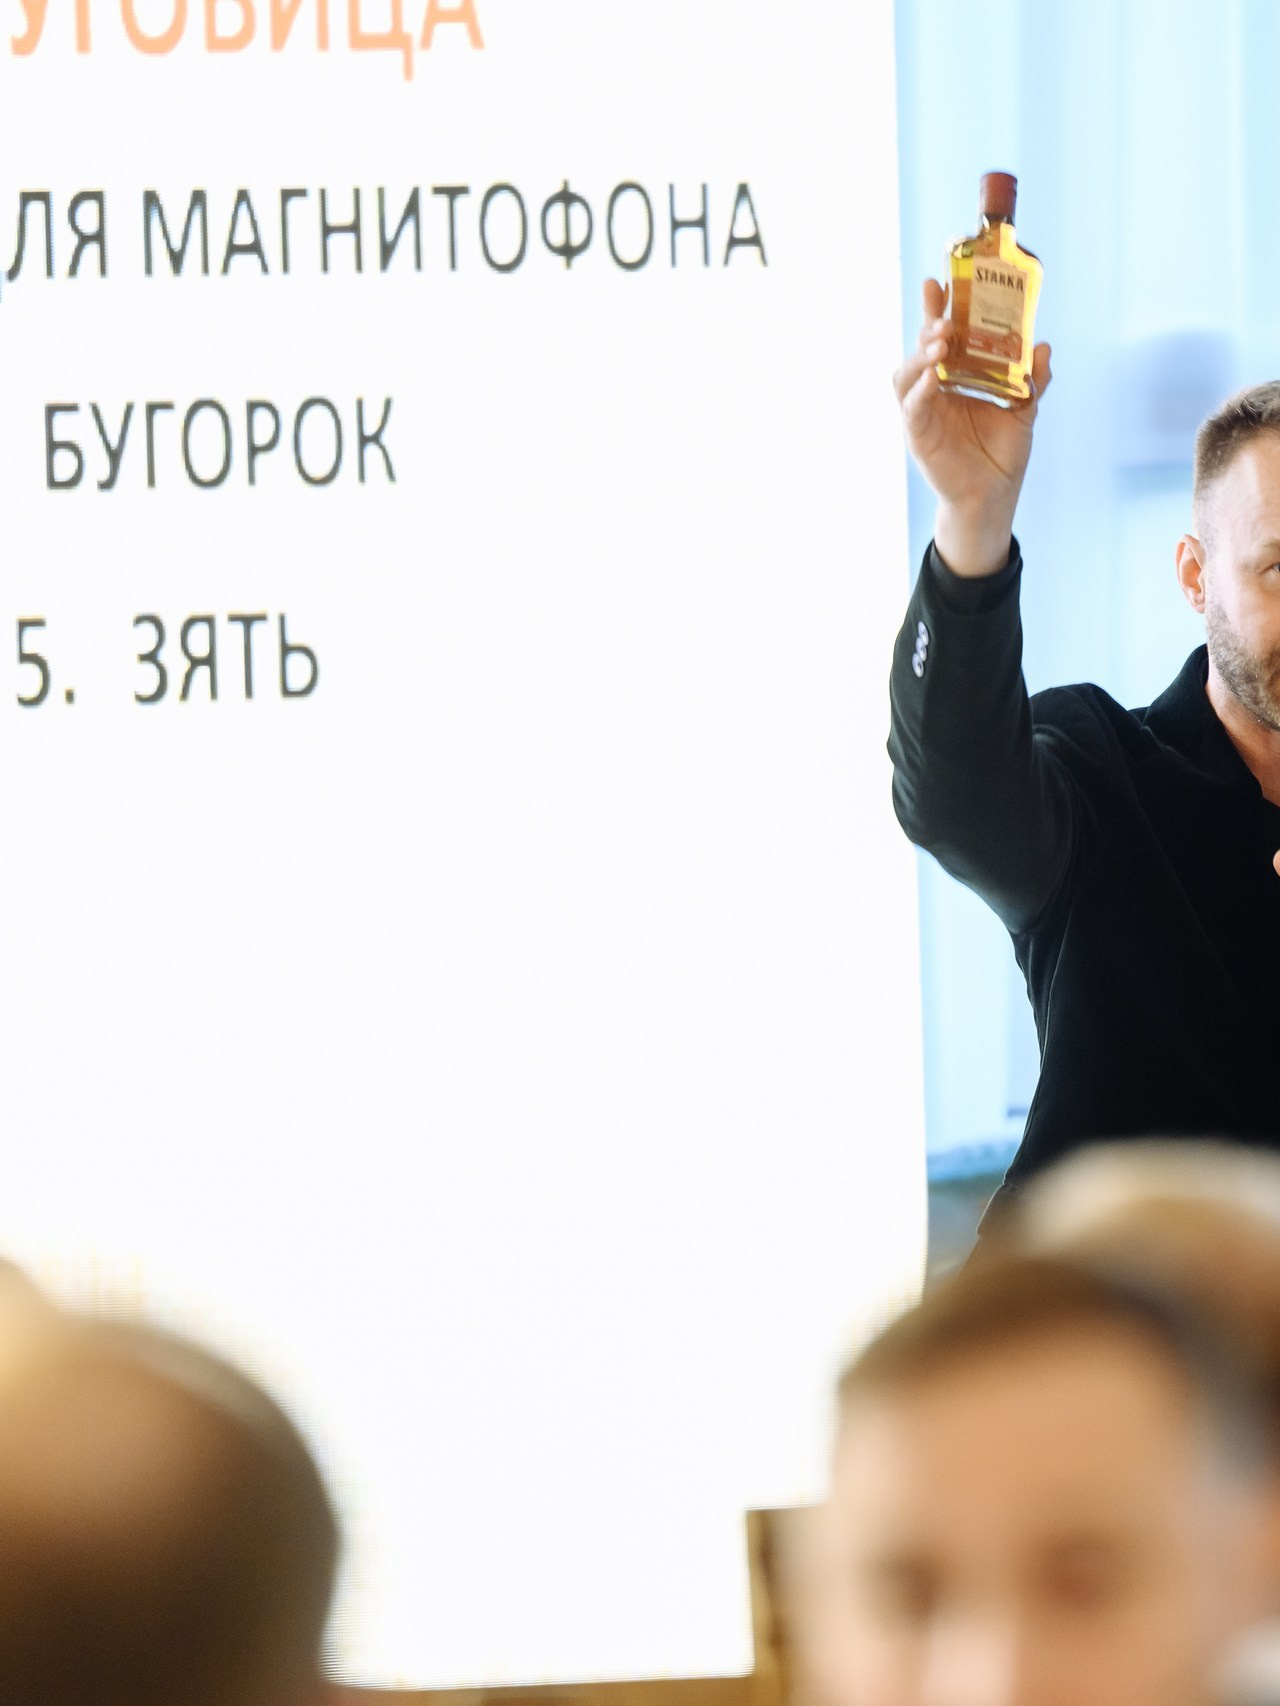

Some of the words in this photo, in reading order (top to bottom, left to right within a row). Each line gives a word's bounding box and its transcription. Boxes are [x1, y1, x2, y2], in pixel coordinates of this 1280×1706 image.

[142, 180, 768, 277] МАГНИТОФОНА
[976, 267, 1024, 293] STARKA
[44, 396, 396, 492] БУГОРОК
[16, 617, 75, 708] 5.
[132, 612, 319, 705] ЗЯТЬ
